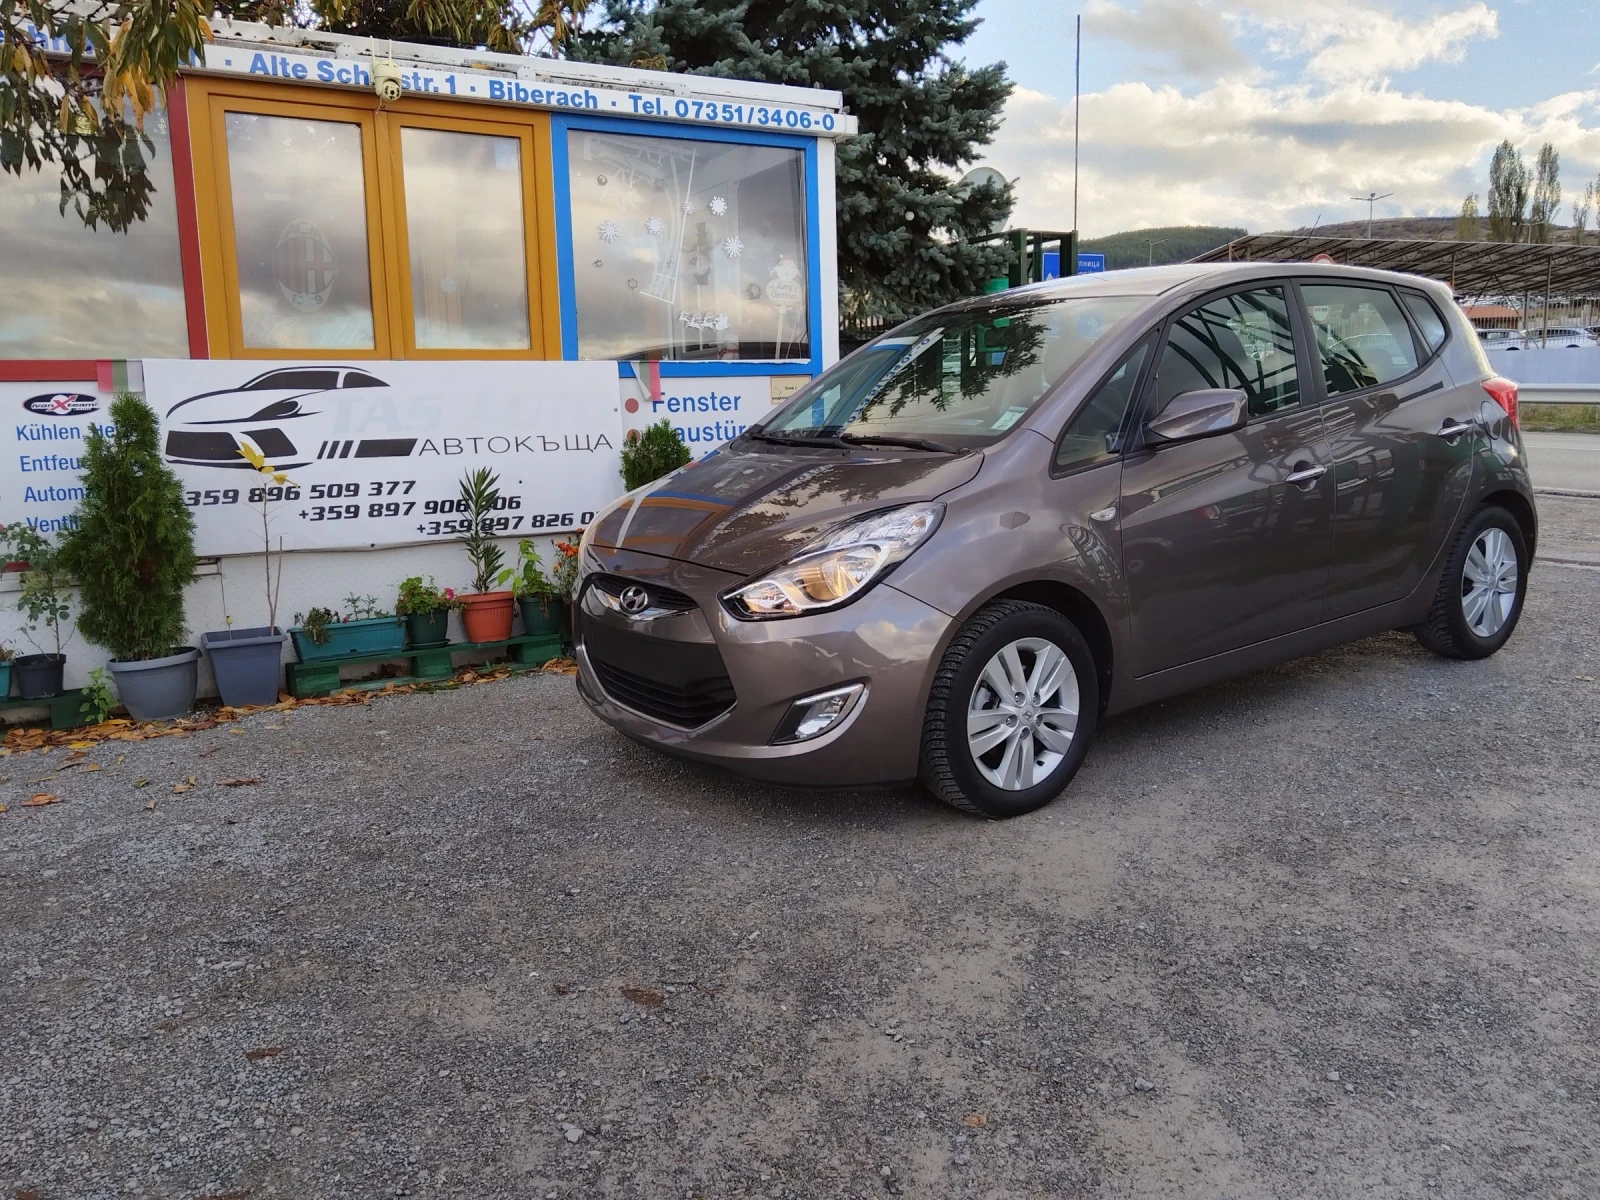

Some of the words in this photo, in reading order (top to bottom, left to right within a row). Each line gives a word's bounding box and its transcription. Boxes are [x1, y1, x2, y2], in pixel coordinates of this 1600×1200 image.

[249, 53, 308, 79] Alte
[317, 60, 439, 93] Schstr.
[445, 74, 456, 95] 1
[489, 79, 598, 109] Biberach
[628, 94, 669, 116] Tel.
[675, 99, 835, 131] 07351/3406-0
[1077, 260, 1100, 269] пница
[652, 391, 741, 413] Fenster
[16, 423, 81, 441] Kühlen
[653, 420, 747, 443] austür
[418, 433, 613, 457] АВТОКЪЩА
[19, 454, 83, 472] Entfeu
[23, 485, 86, 503] Autom
[185, 489, 239, 506] 359
[248, 486, 300, 503] 896
[309, 482, 360, 500] 509
[368, 480, 416, 497] 377
[299, 504, 360, 521] +359
[368, 501, 416, 518] 897
[424, 498, 470, 514] 906
[484, 495, 522, 511] 06
[417, 518, 472, 536] +359
[480, 515, 524, 532] 897
[531, 512, 574, 528] 826
